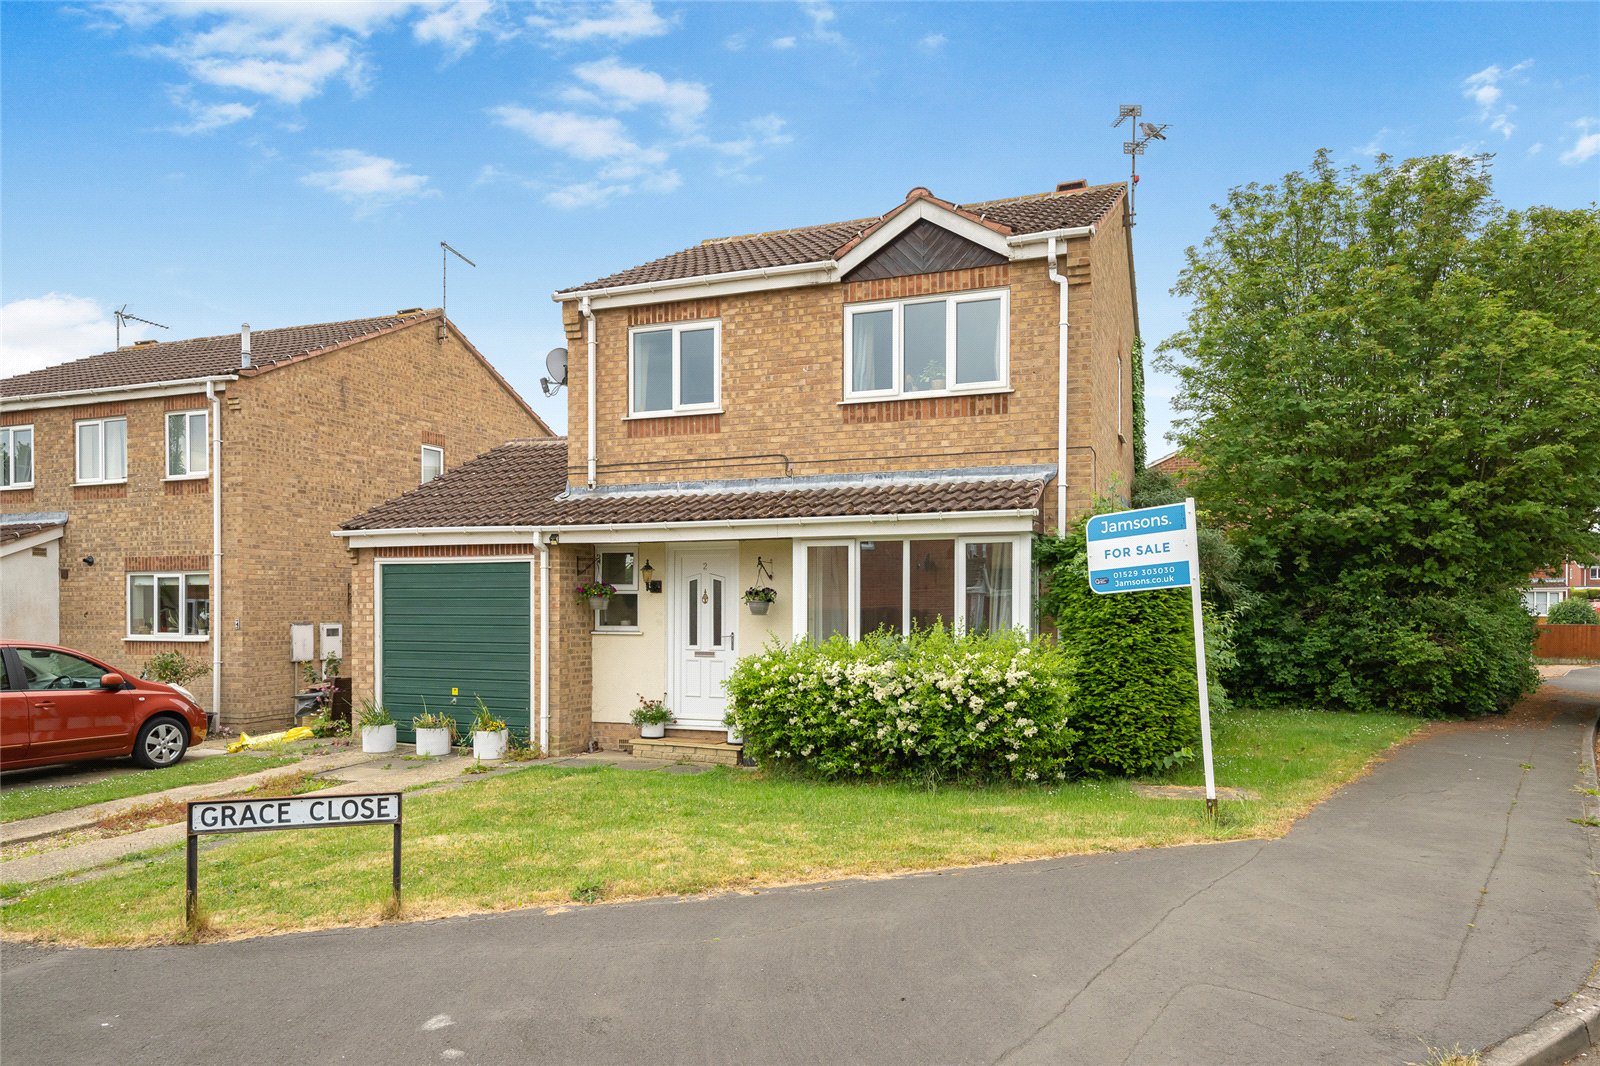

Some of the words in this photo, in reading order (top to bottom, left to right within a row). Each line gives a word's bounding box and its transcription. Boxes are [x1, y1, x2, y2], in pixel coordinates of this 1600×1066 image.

[1101, 515, 1172, 534] Jamsons.
[1104, 547, 1131, 560] FOR
[1136, 542, 1171, 556] SALE
[1113, 570, 1138, 579] 01529
[1141, 566, 1175, 576] 303030
[1115, 575, 1174, 588] Jamsons.co.uk
[200, 802, 291, 828] GRACE
[309, 797, 391, 822] CLOSE
